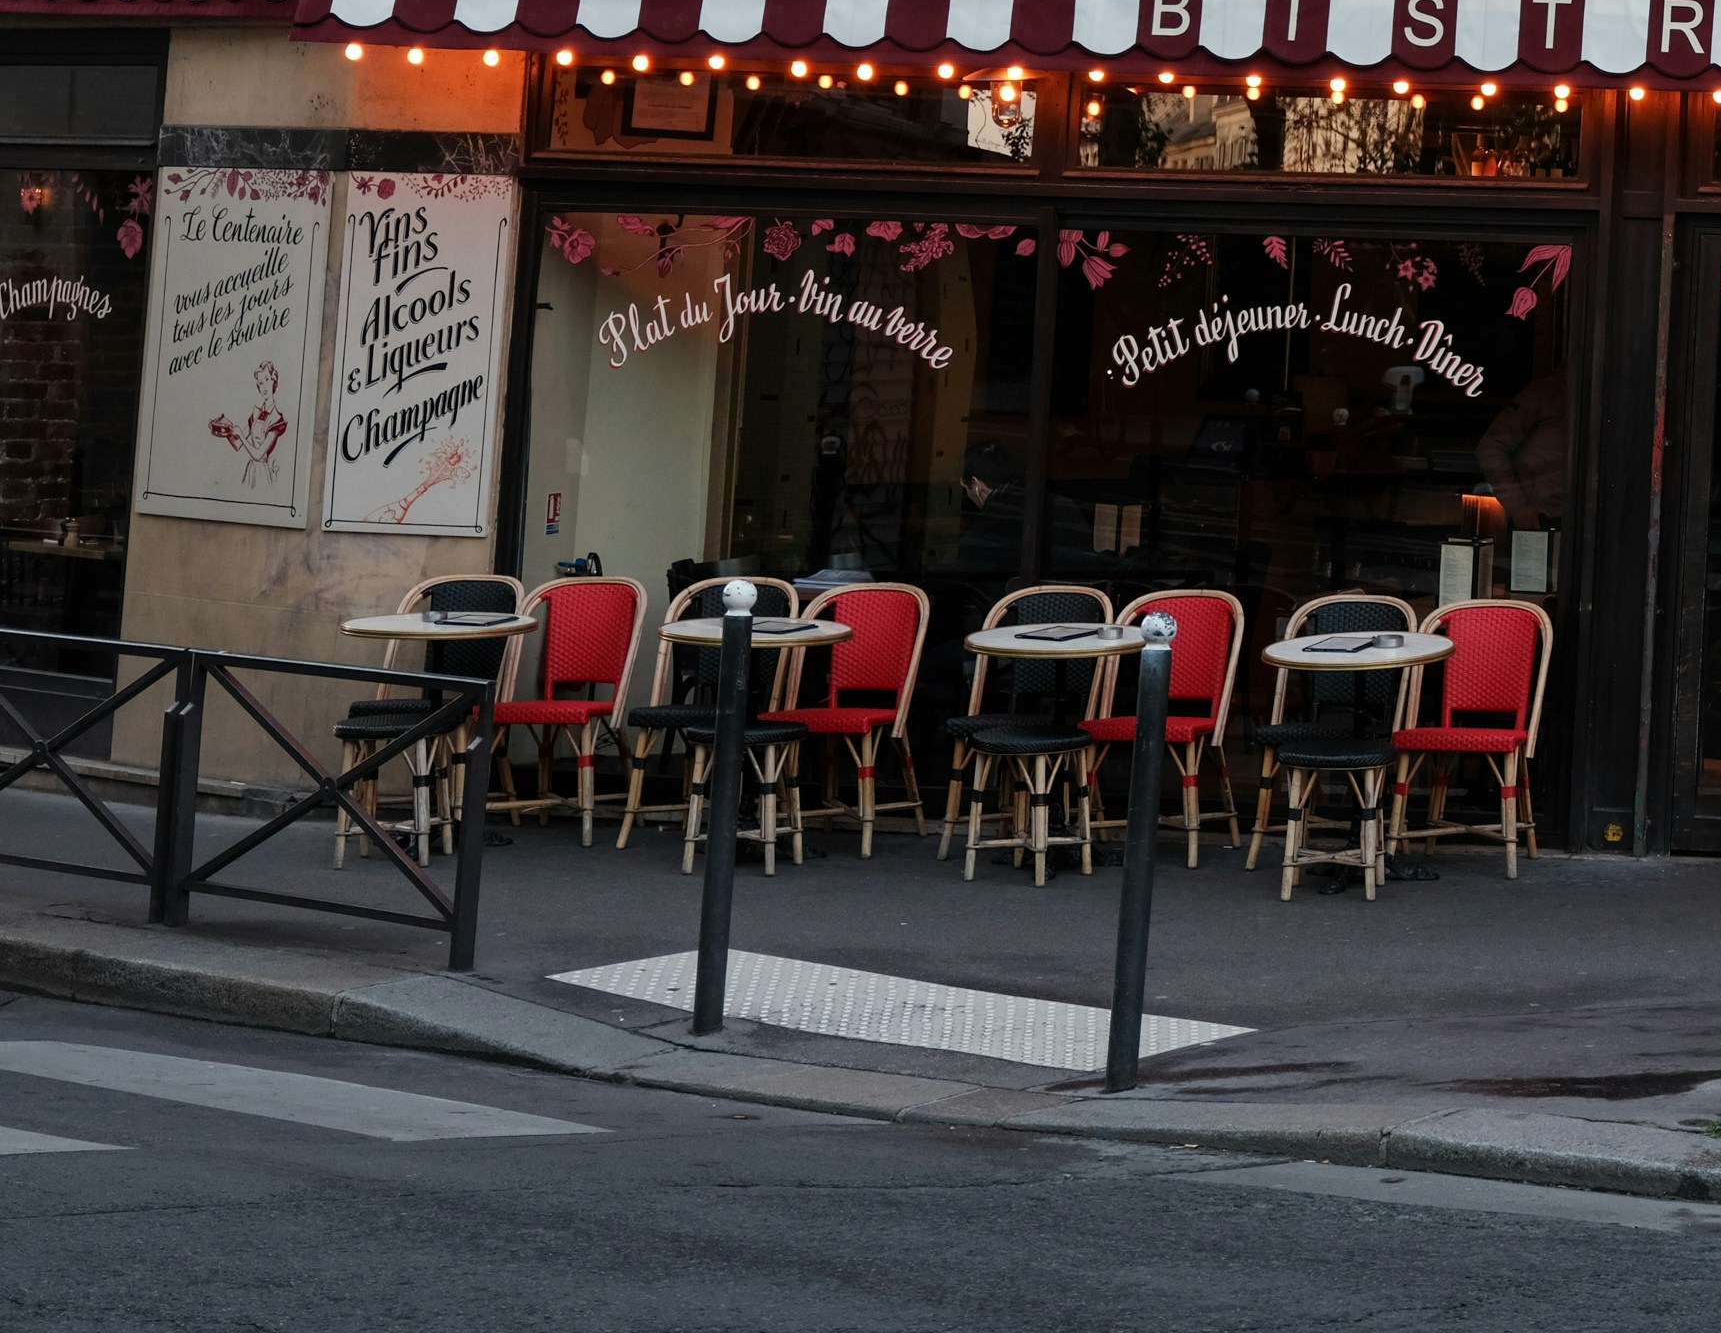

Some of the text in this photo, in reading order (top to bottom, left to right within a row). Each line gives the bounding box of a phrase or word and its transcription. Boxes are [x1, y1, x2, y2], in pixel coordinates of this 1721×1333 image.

[180, 205, 305, 247] Le Centenaire
[358, 204, 428, 258] Vins
[0, 274, 113, 321] Champagnes
[172, 272, 293, 345] tous les jours
[173, 246, 290, 315] vous accueille
[360, 269, 472, 347] Alcools
[168, 304, 291, 377] avec le sourire
[364, 314, 481, 391] Liqueurs
[599, 293, 676, 369] Plat
[679, 291, 714, 329] du
[713, 272, 786, 344] Jour
[848, 296, 884, 332] au
[1111, 282, 1484, 399] Petit déjeuner Lunch Dîner
[341, 371, 485, 465] Champagne
